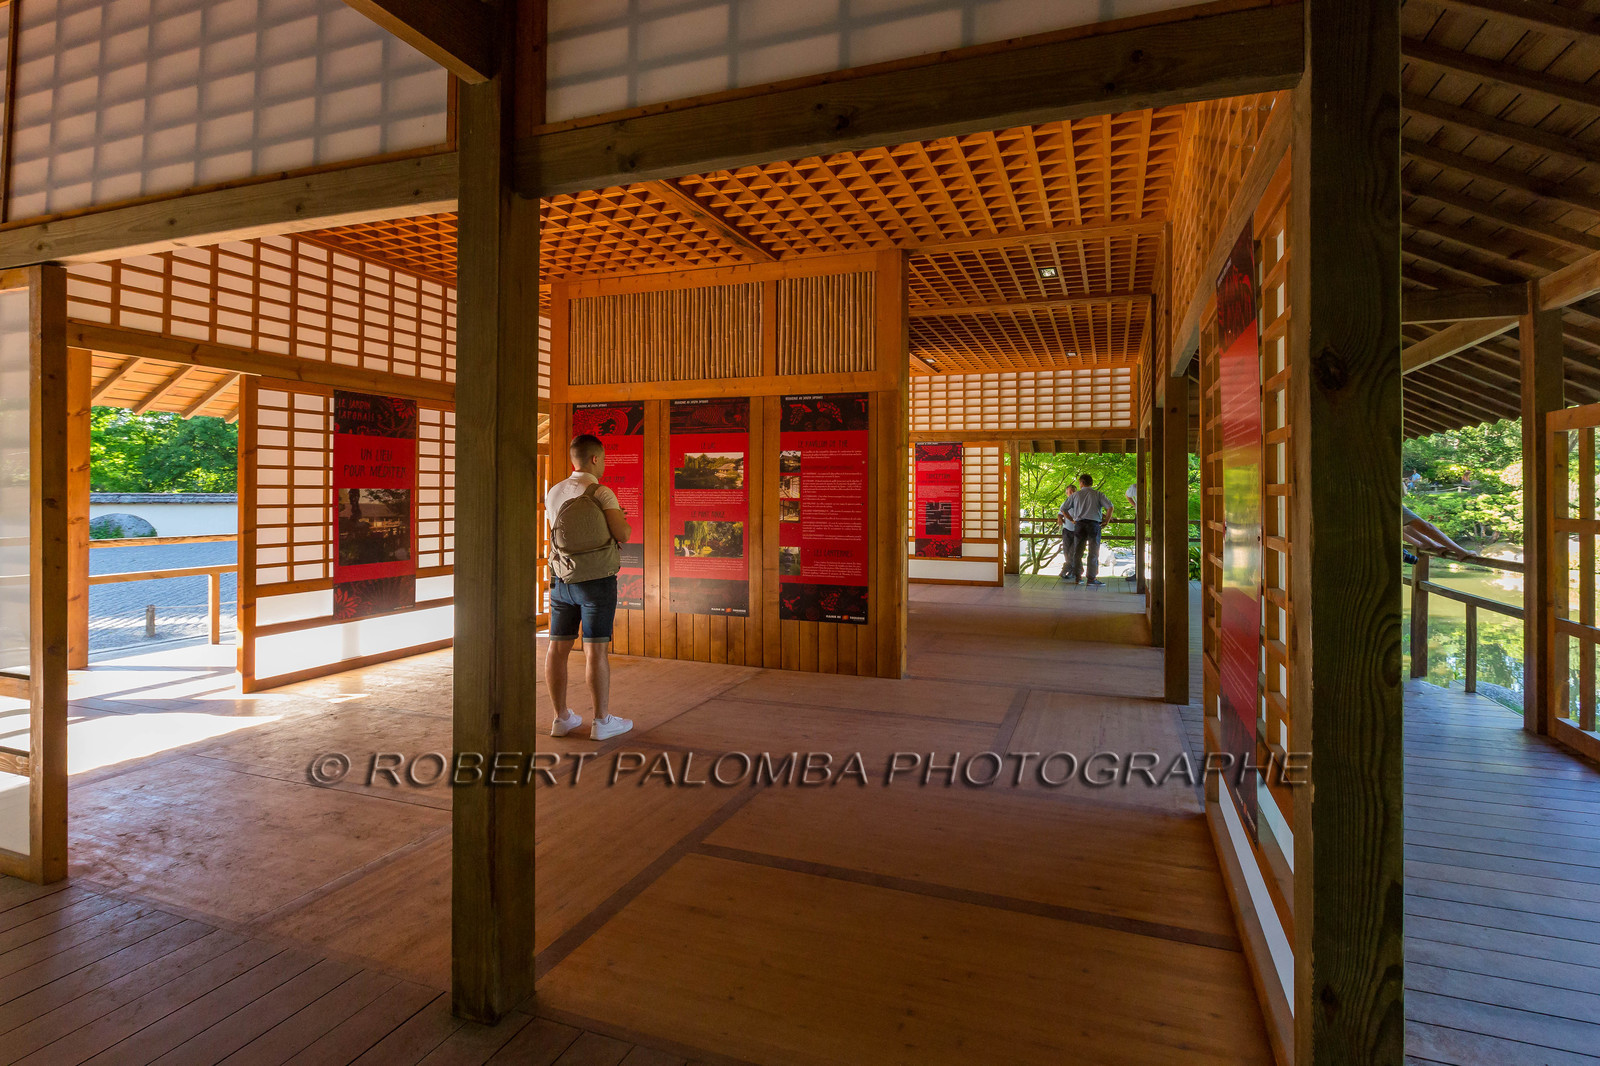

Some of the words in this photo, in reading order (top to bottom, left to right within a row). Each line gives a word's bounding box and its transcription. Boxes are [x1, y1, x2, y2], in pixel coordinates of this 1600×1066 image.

[360, 448, 372, 461] UN
[376, 449, 392, 462] LIEU
[344, 464, 366, 478] POUR
